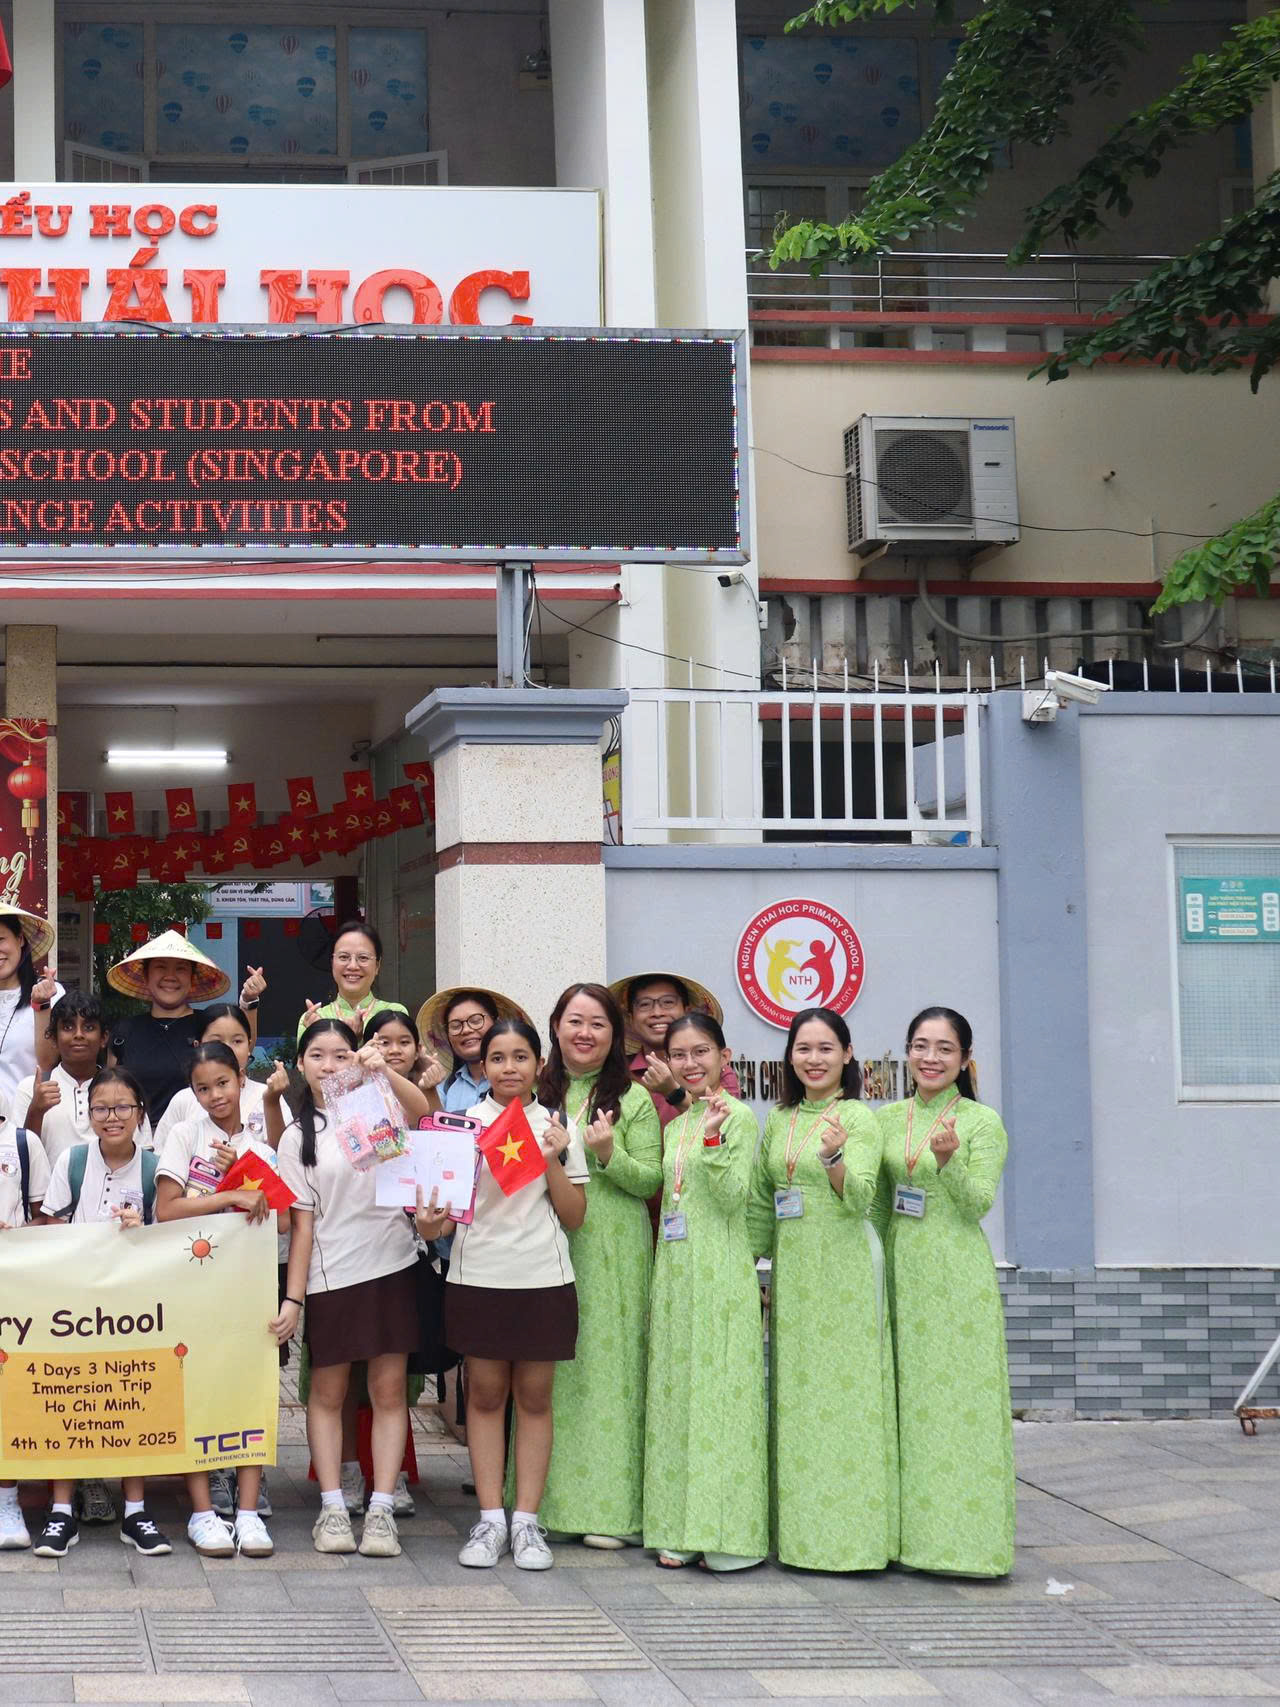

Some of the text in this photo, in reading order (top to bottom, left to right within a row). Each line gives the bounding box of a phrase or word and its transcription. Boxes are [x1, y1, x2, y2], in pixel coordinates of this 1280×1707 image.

[89, 203, 218, 244] HỌC
[23, 399, 117, 431] AND
[130, 399, 353, 431] STUDENTS
[365, 399, 495, 433] FROM
[0, 449, 177, 481] SCHOOL
[187, 448, 463, 489] (SINGAPORE)
[104, 499, 348, 533] ACTIVITIES
[741, 904, 860, 969] NGUYEN THAI HOC PRIMARY SCHOOL
[789, 975, 813, 985] NTH
[50, 1302, 164, 1337] School
[26, 1359, 156, 1380] 4 Days 3 Nights
[31, 1379, 152, 1395] Immersion Trip
[45, 1397, 146, 1413] Ho Chi Minh,
[62, 1418, 125, 1432] Vietnam
[10, 1431, 177, 1450] 4th to 7th Nov 2025
[194, 1429, 265, 1454] TCF
[208, 1454, 249, 1463] EXPERIENCES
